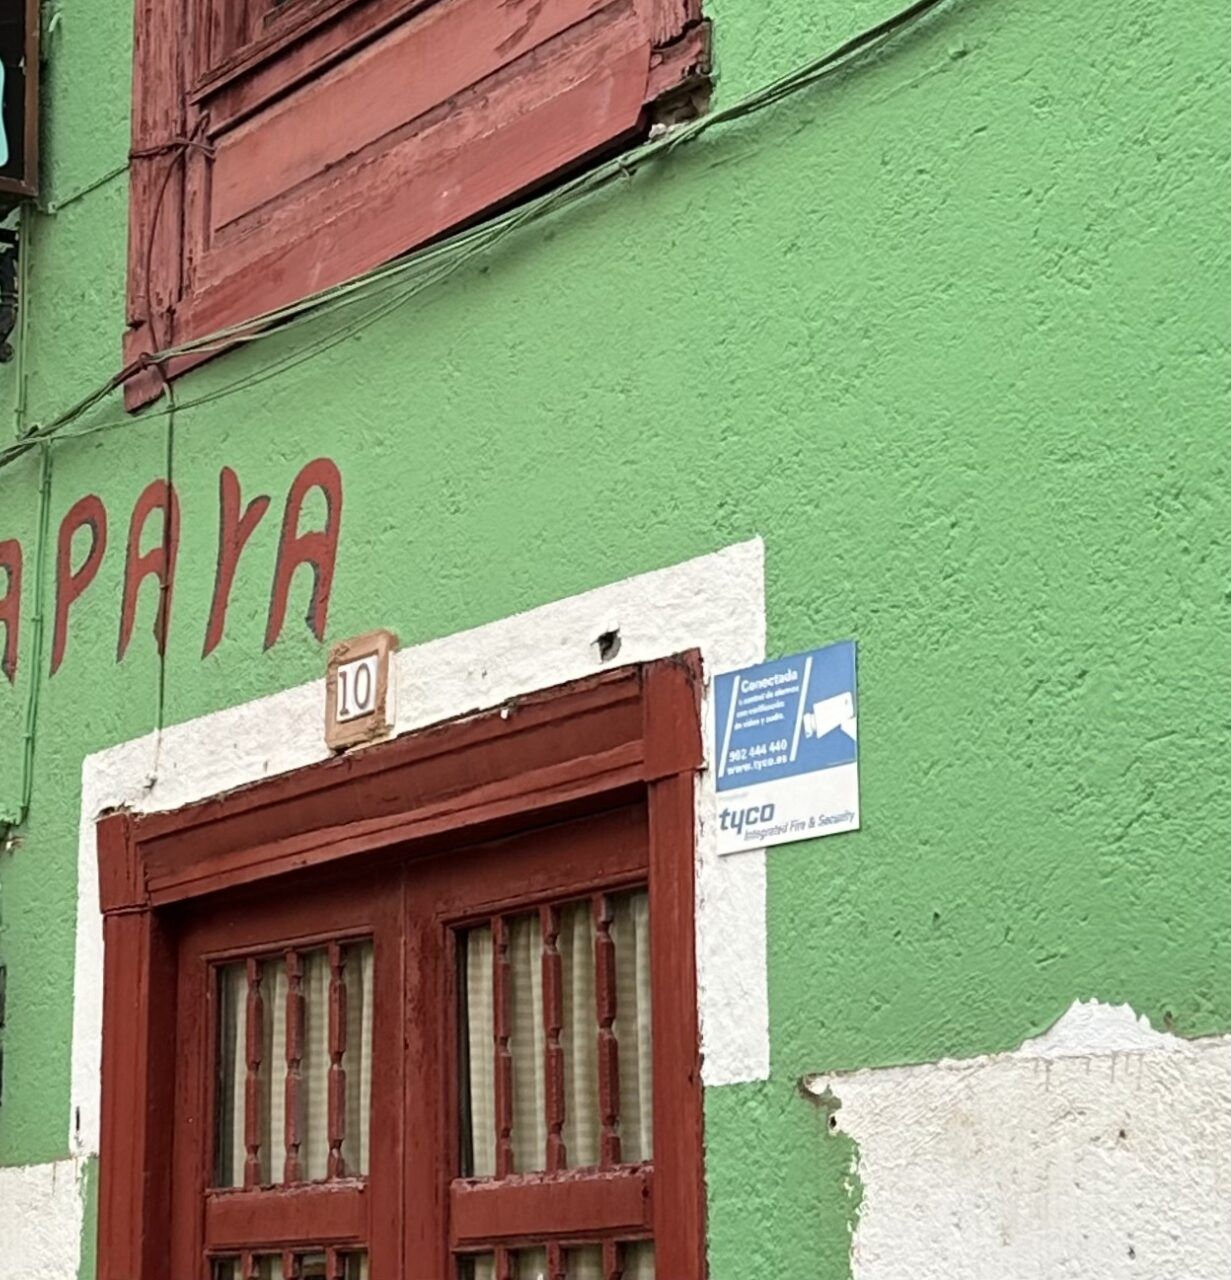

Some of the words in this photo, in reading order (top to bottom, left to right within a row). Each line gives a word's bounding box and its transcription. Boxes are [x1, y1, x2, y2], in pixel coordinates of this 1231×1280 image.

[338, 663, 372, 716] 10
[727, 754, 788, 775] www.tyco.es
[719, 803, 775, 835] tyco
[744, 822, 789, 841] Integrated
[789, 819, 807, 833] Fire
[817, 809, 856, 827] Security
